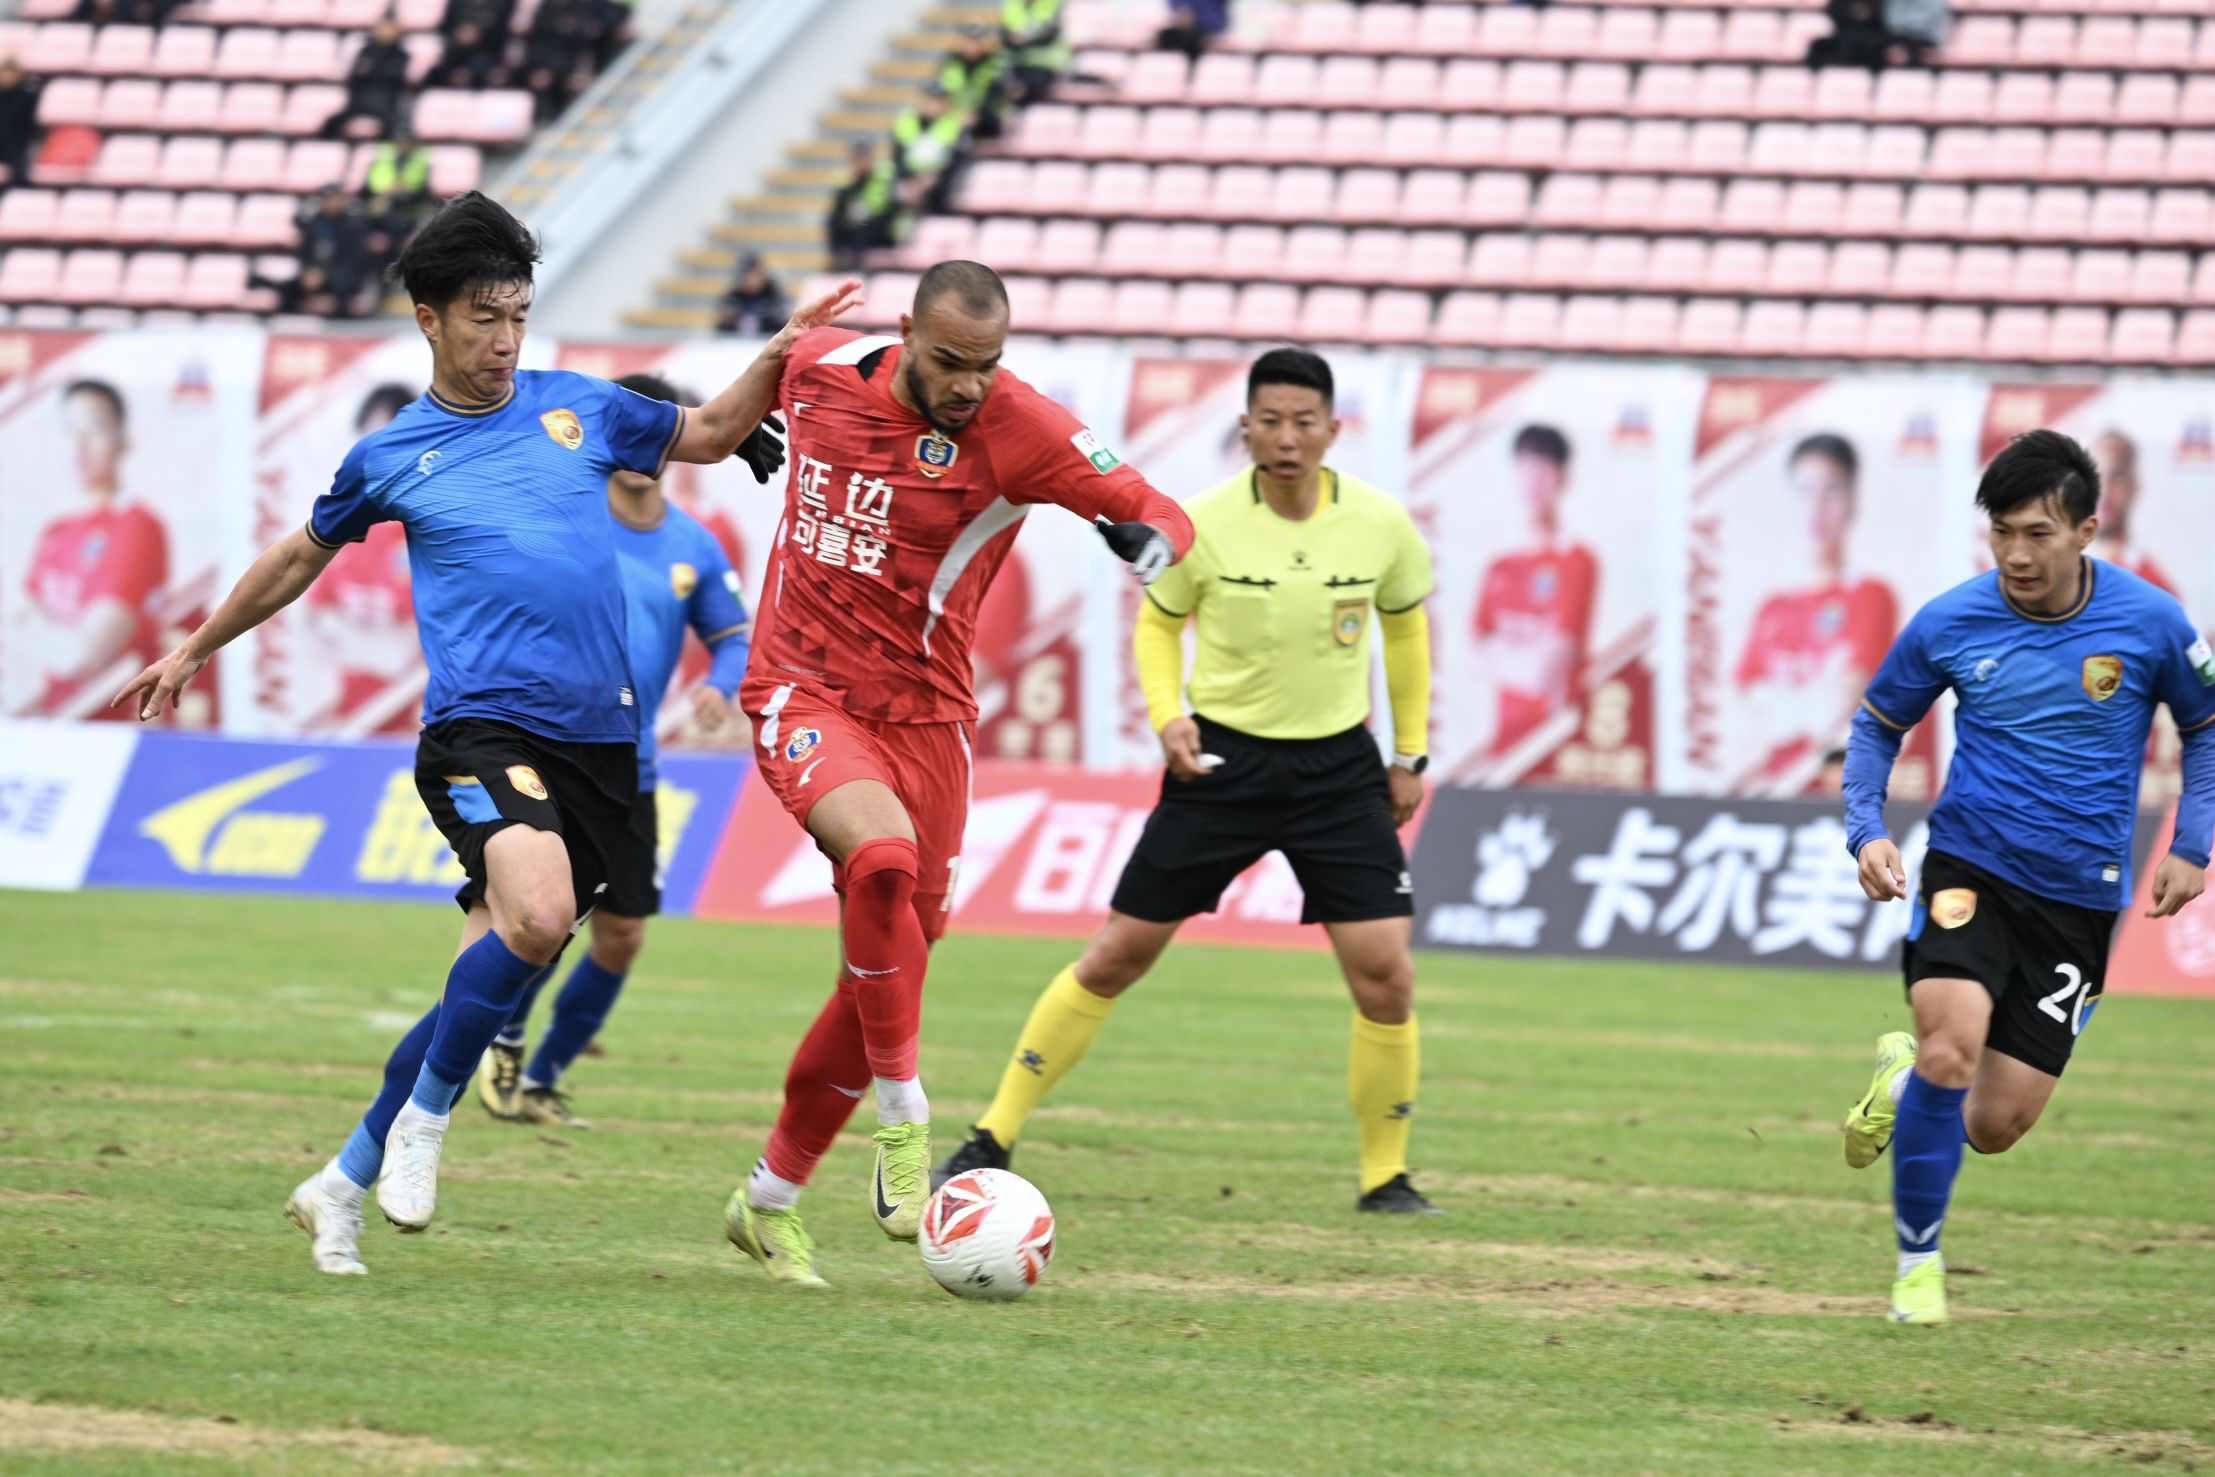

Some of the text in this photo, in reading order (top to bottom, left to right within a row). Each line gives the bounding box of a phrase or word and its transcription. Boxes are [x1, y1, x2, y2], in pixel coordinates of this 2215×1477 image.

[791, 508, 888, 577] 可喜安
[1018, 655, 1064, 722] 6
